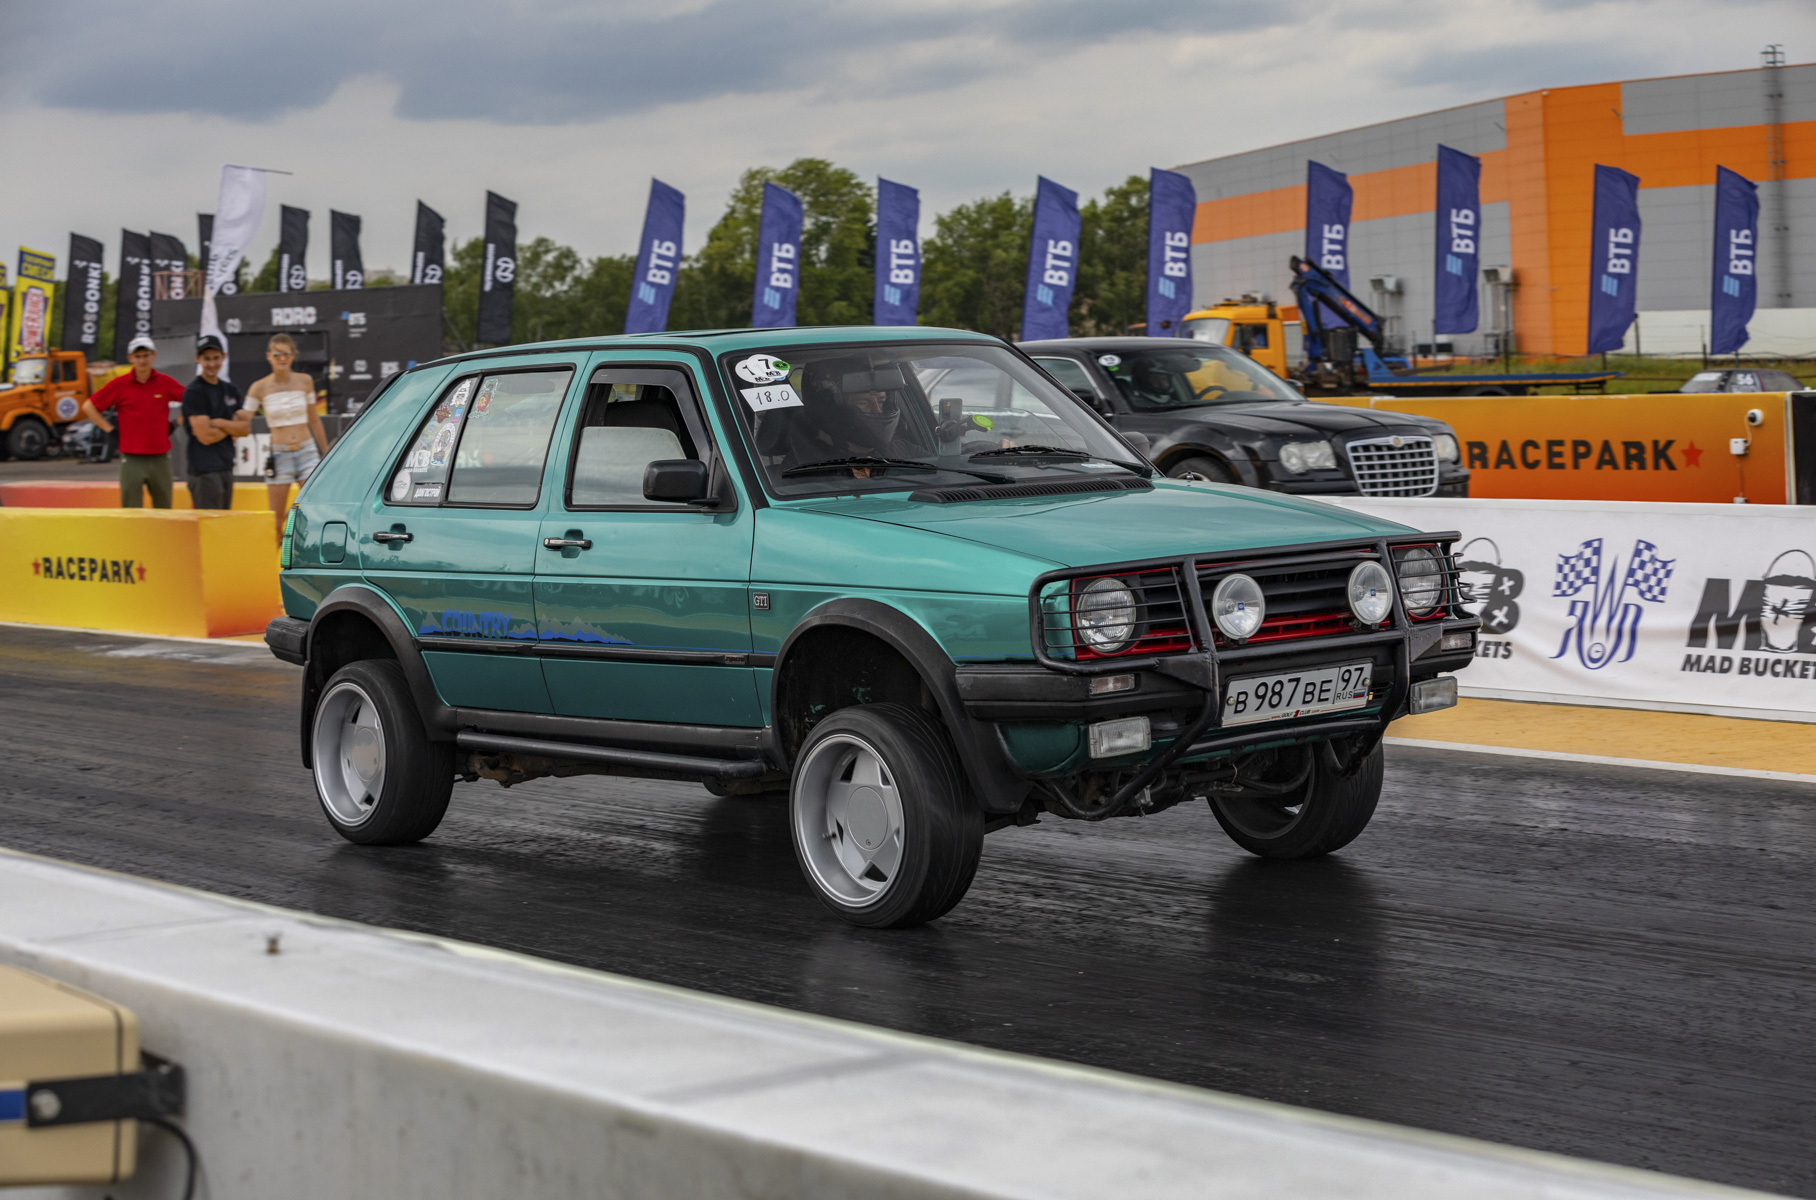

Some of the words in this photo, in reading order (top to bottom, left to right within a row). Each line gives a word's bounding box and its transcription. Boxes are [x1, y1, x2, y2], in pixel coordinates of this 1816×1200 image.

[1163, 231, 1189, 278] ВТБ
[1322, 223, 1345, 271] ВТБ
[1451, 208, 1476, 255] ВТБ
[1607, 227, 1634, 275] ВТБ
[1729, 228, 1755, 276] ВТБ
[646, 239, 677, 286] ВТБ
[769, 242, 796, 289] ВТБ
[889, 239, 915, 285] ВТБ
[1043, 239, 1073, 287] ВТБ
[1466, 439, 1679, 471] RACEPARK
[41, 556, 136, 585] RACEPARK
[753, 595, 768, 606] GTI
[1341, 666, 1365, 691] 97
[1681, 654, 1734, 675] MAD
[1335, 690, 1353, 700] RUS
